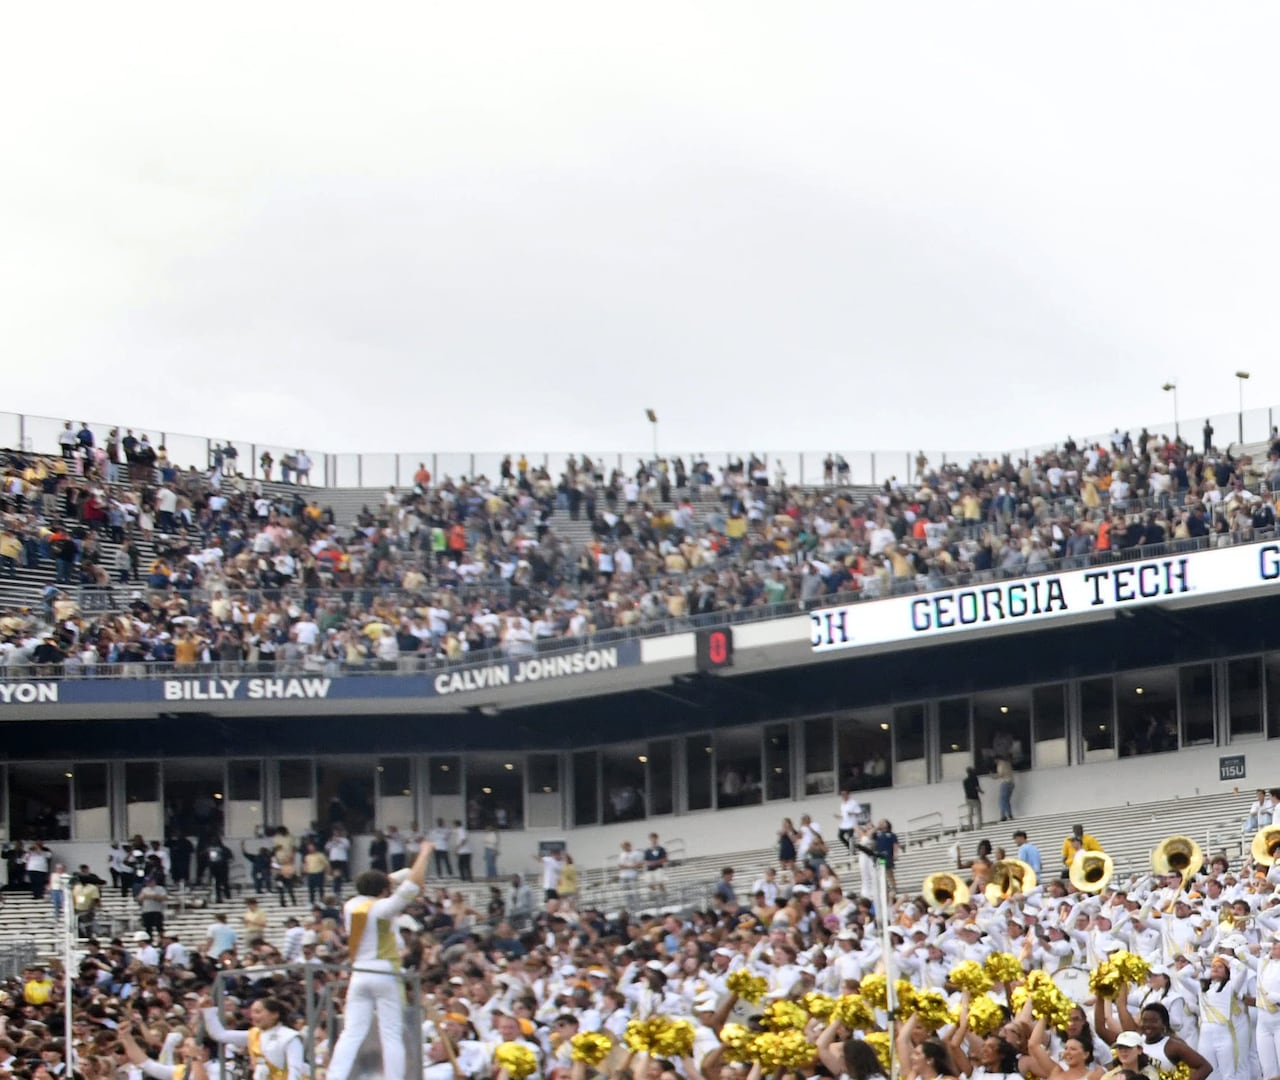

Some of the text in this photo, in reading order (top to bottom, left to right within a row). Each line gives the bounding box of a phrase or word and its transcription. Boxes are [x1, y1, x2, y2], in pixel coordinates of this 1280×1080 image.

[910, 559, 1190, 632] GEORGIA TECH
[164, 677, 331, 700] BILLY SHAW
[434, 646, 618, 695] CALVIN JOHNSON
[1221, 765, 1244, 777] 115U
